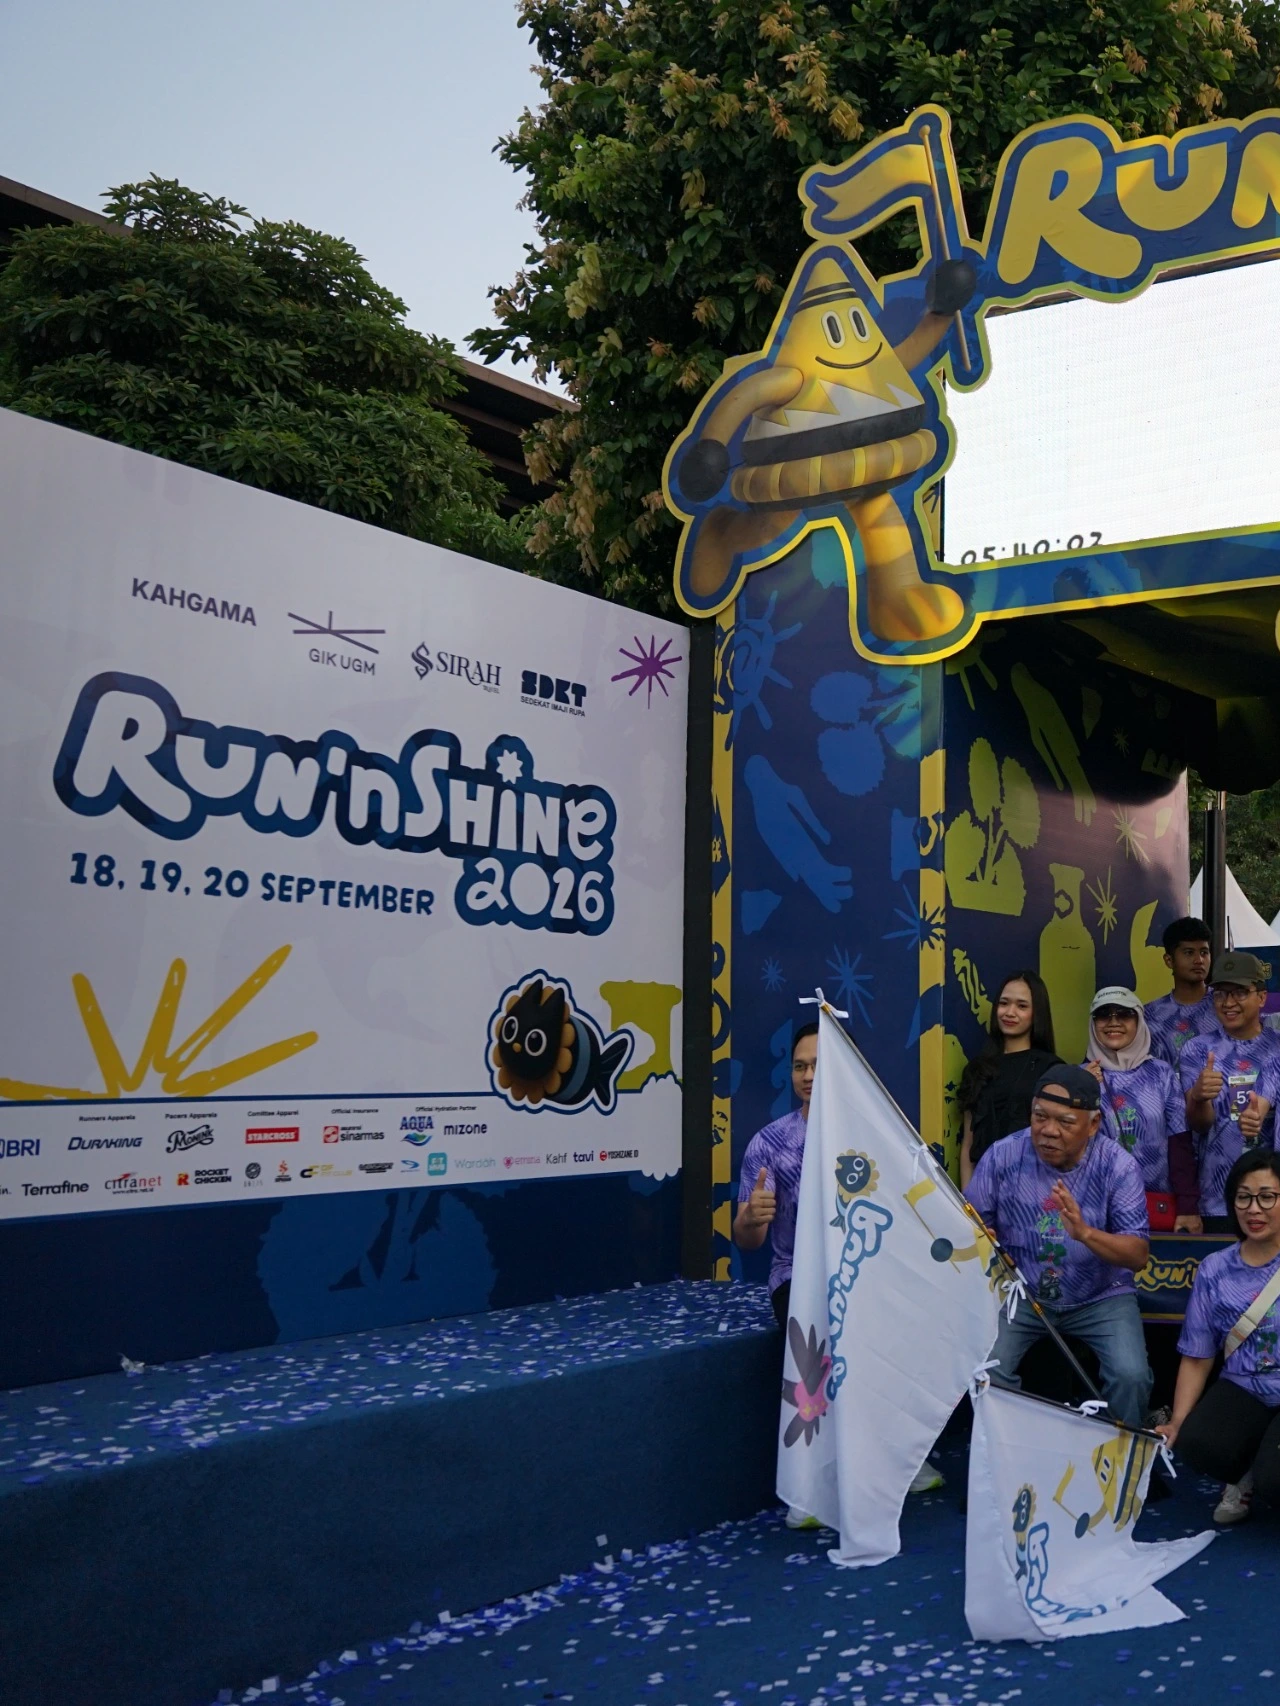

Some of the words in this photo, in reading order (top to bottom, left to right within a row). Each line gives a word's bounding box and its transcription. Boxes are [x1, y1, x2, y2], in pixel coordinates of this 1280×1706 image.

[132, 578, 257, 626] KAHGAMA
[309, 648, 337, 667] GIK
[339, 656, 376, 676] UGM
[437, 652, 502, 687] SIRAH
[521, 670, 587, 707] SDKT
[520, 696, 551, 709] SEDEKAT
[551, 702, 568, 713] IMAJI
[569, 707, 586, 717] RUPA
[69, 851, 125, 891] 18,
[140, 858, 191, 897] 19,
[204, 866, 250, 898] 20
[261, 871, 435, 916] SEPTEMBER
[466, 860, 606, 923] 2026
[400, 1116, 435, 1132] AQUA
[443, 1123, 488, 1136] mizone
[67, 1136, 144, 1151] DURAKING
[247, 1131, 296, 1142] STARCROSS
[340, 1130, 385, 1142] sinarmas
[6, 1139, 41, 1157] BRI
[454, 1157, 496, 1169] Wardah
[546, 1152, 568, 1164] Kahf
[573, 1150, 595, 1163] tavi
[194, 1168, 229, 1177] ROCKET
[194, 1175, 232, 1185] CHICKEN
[21, 1180, 89, 1197] Terrafine
